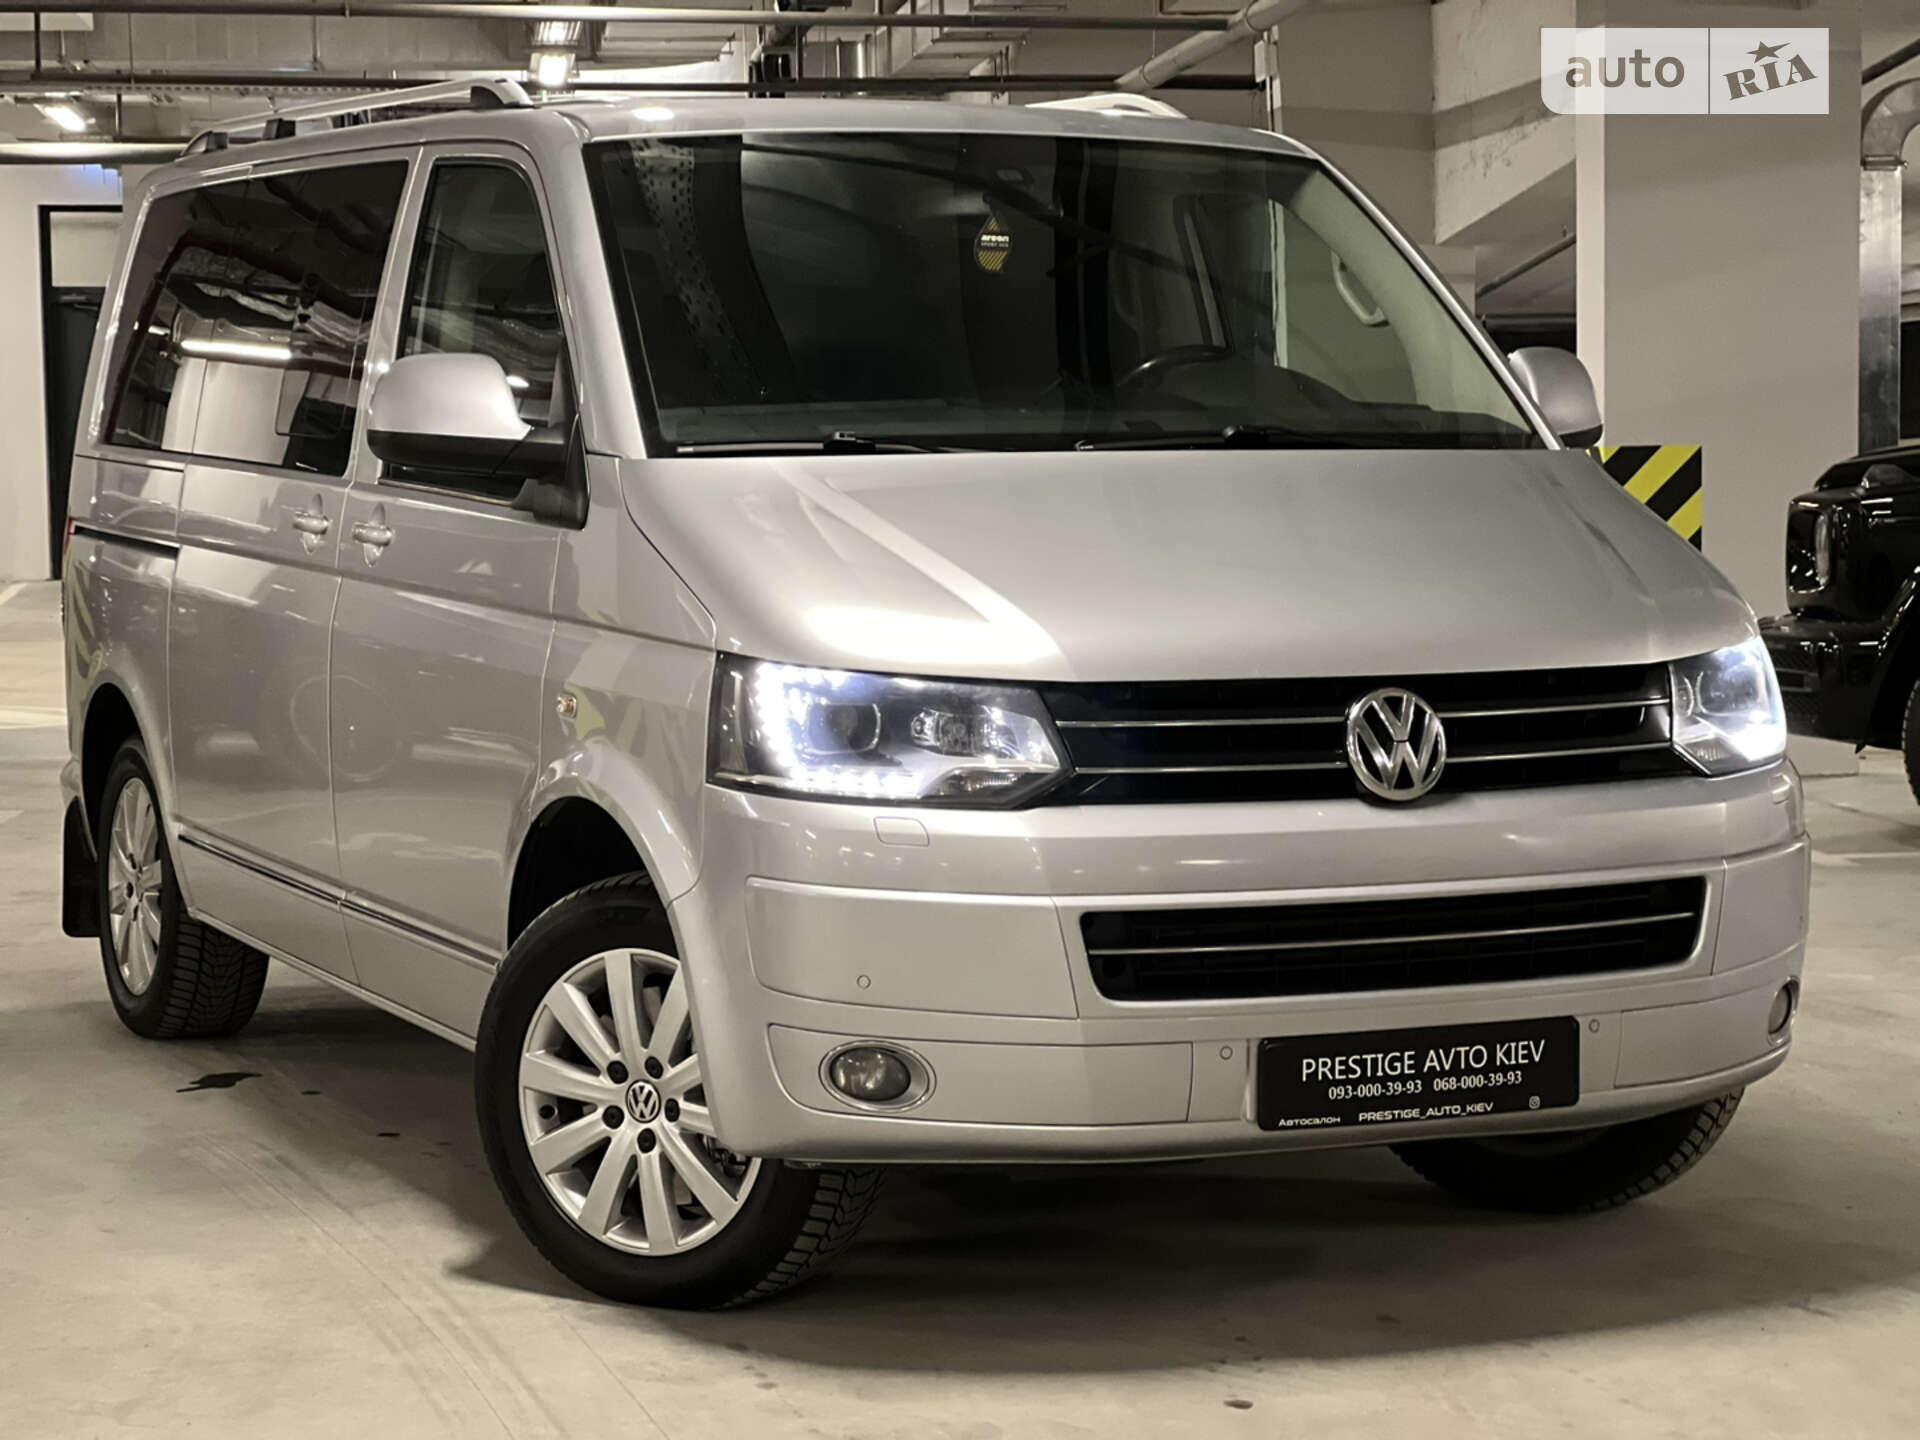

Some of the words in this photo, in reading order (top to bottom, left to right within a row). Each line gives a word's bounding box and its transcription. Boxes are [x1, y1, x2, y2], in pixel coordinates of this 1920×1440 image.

[1301, 1051, 1416, 1082] PRESTIGE
[1423, 1044, 1488, 1072] AVTO
[1496, 1039, 1545, 1067] KIEV
[1328, 1079, 1423, 1100] 093-000-39-93
[1433, 1071, 1523, 1092] 068-000-39-93
[1358, 1101, 1494, 1122] PRESTIGE_AUTO_KIEV
